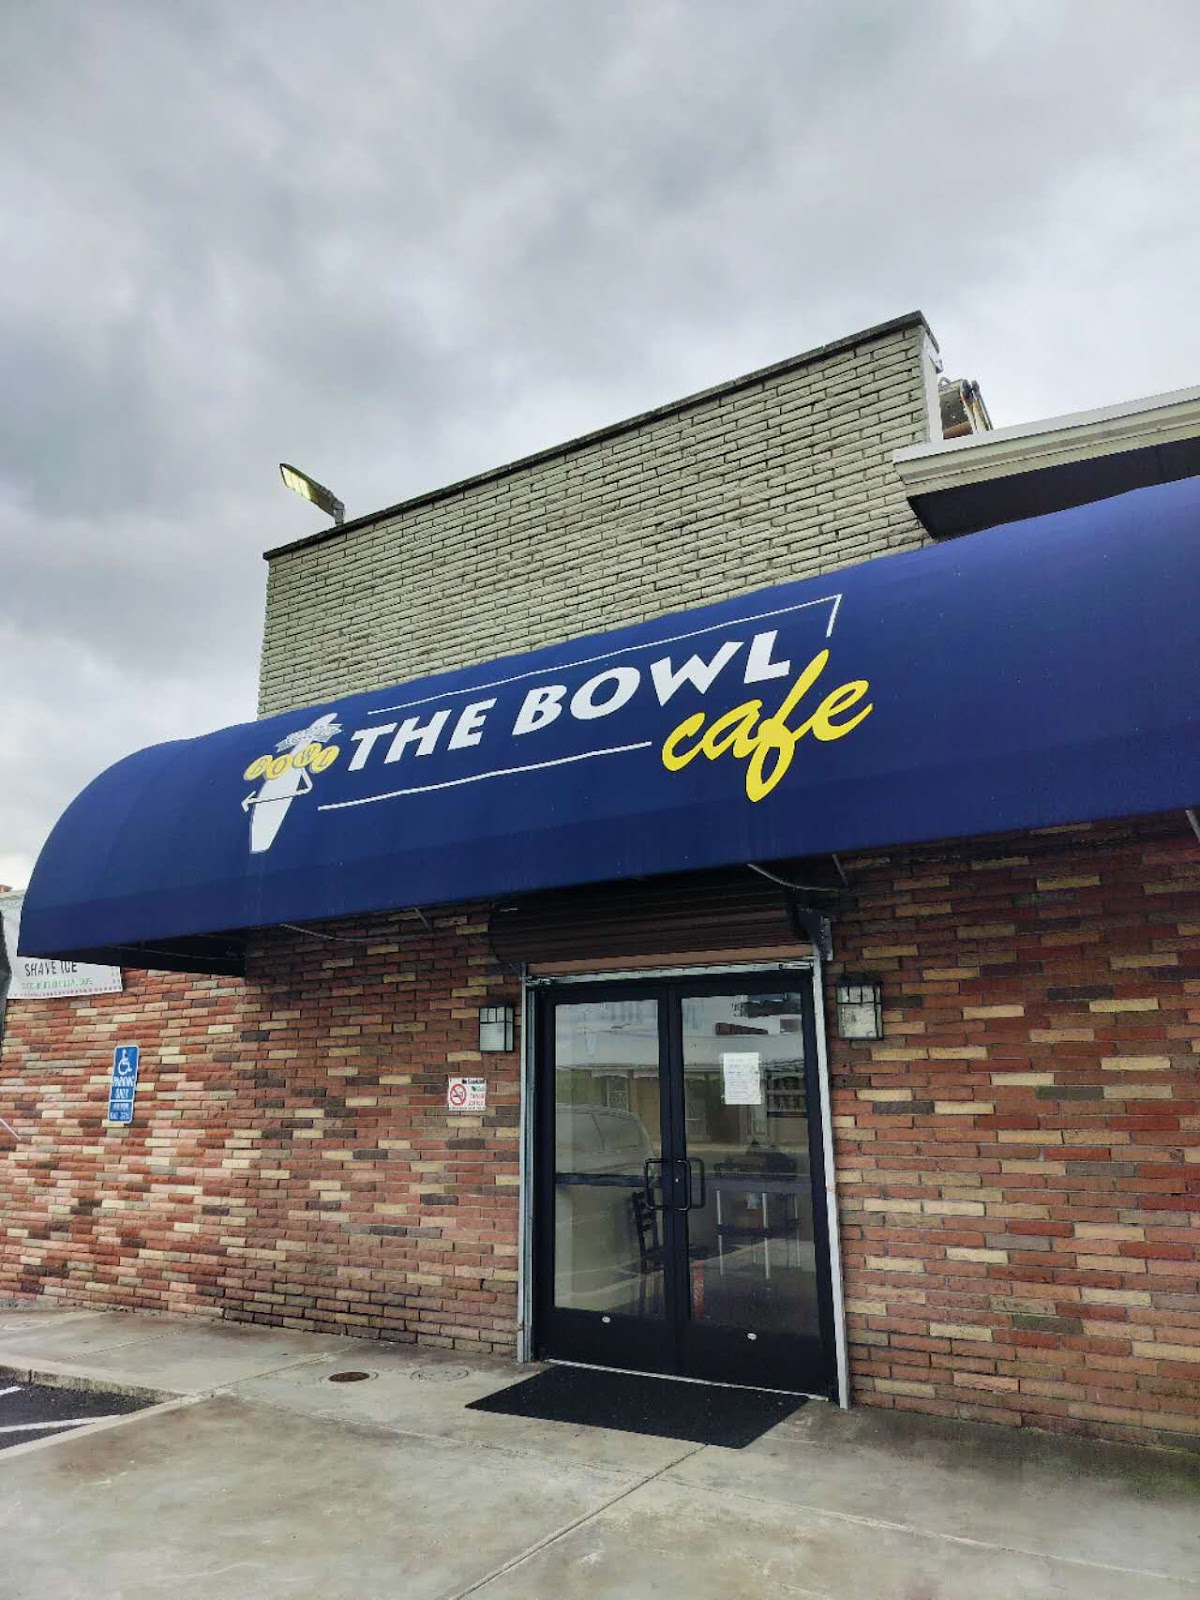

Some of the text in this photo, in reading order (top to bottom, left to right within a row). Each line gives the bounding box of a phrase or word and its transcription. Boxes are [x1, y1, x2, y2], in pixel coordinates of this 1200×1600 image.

[347, 629, 791, 772] THE BOWL
[662, 648, 873, 803] cafe
[24, 961, 57, 977] SHAVE
